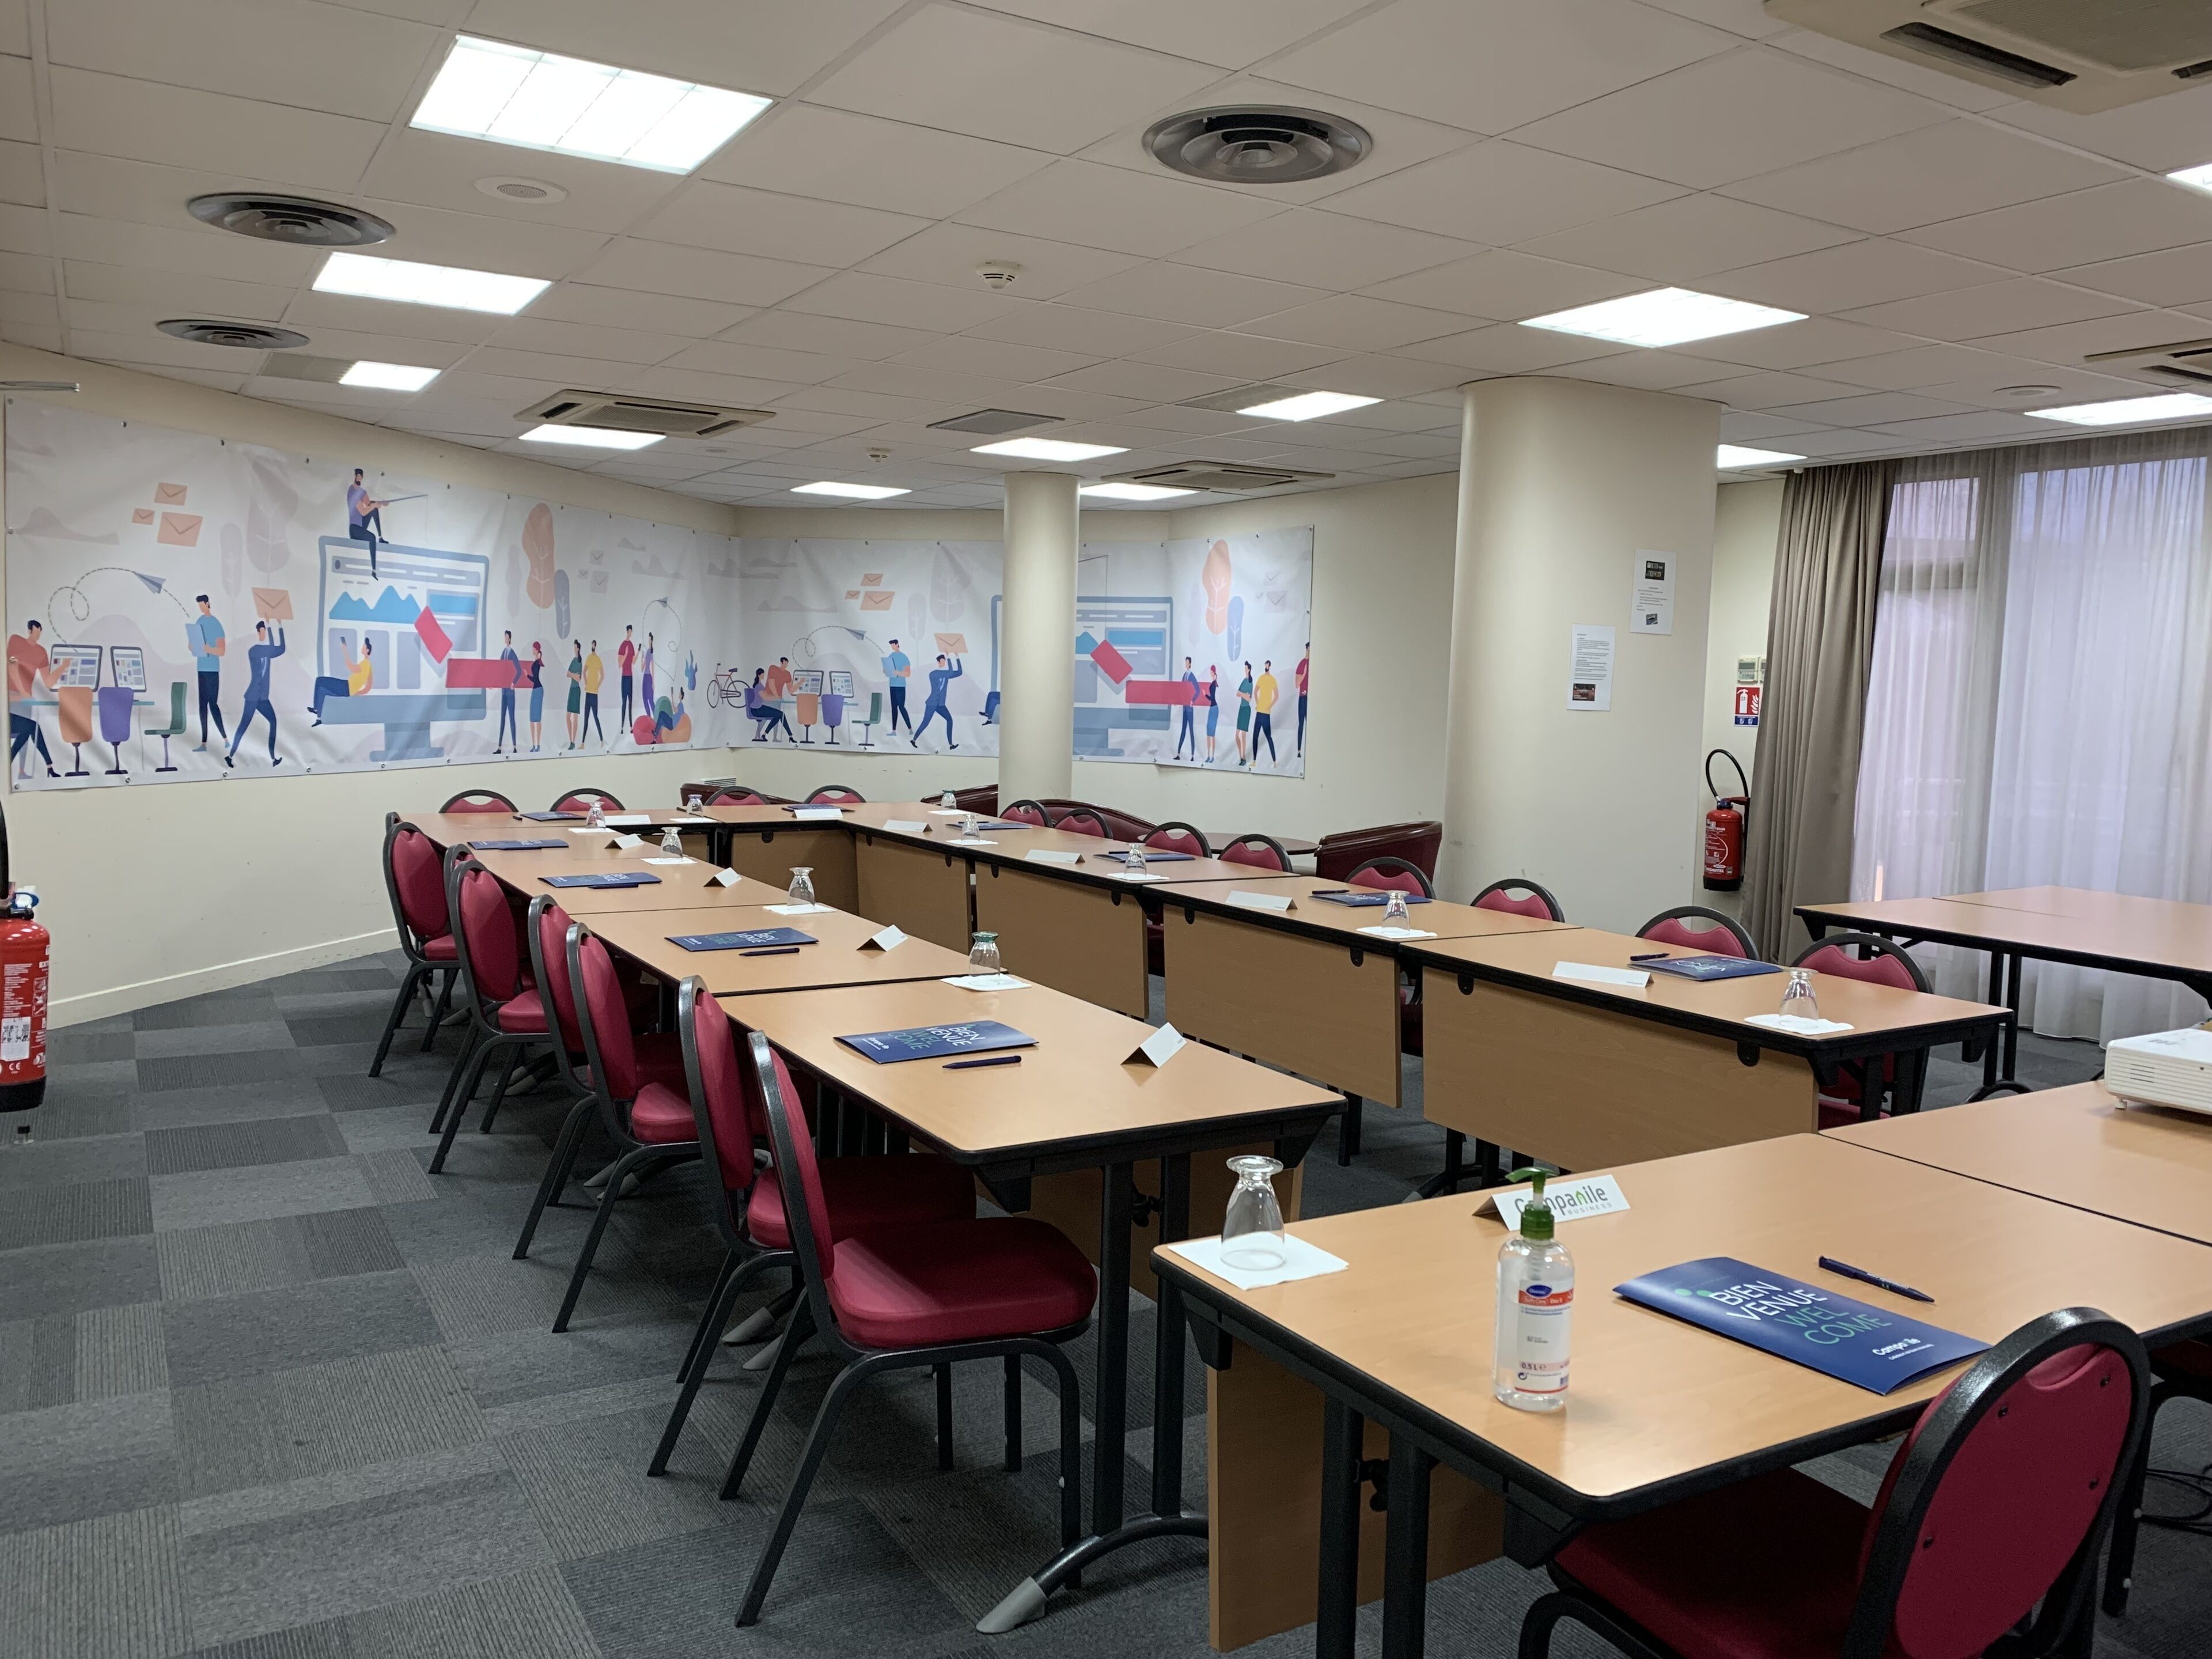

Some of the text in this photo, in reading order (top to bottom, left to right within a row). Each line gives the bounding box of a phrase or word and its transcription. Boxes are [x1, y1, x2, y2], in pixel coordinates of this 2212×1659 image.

[926, 1027, 972, 1047] VENUE
[948, 1027, 986, 1041] BIEN
[1514, 1185, 1608, 1215] Cmpanile
[1567, 1202, 1613, 1215] BUSINESS
[1708, 1280, 1784, 1306] BIEN
[1726, 1289, 1828, 1321] VENUE
[1774, 1306, 1849, 1328] WEL
[1804, 1314, 1893, 1345] COME
